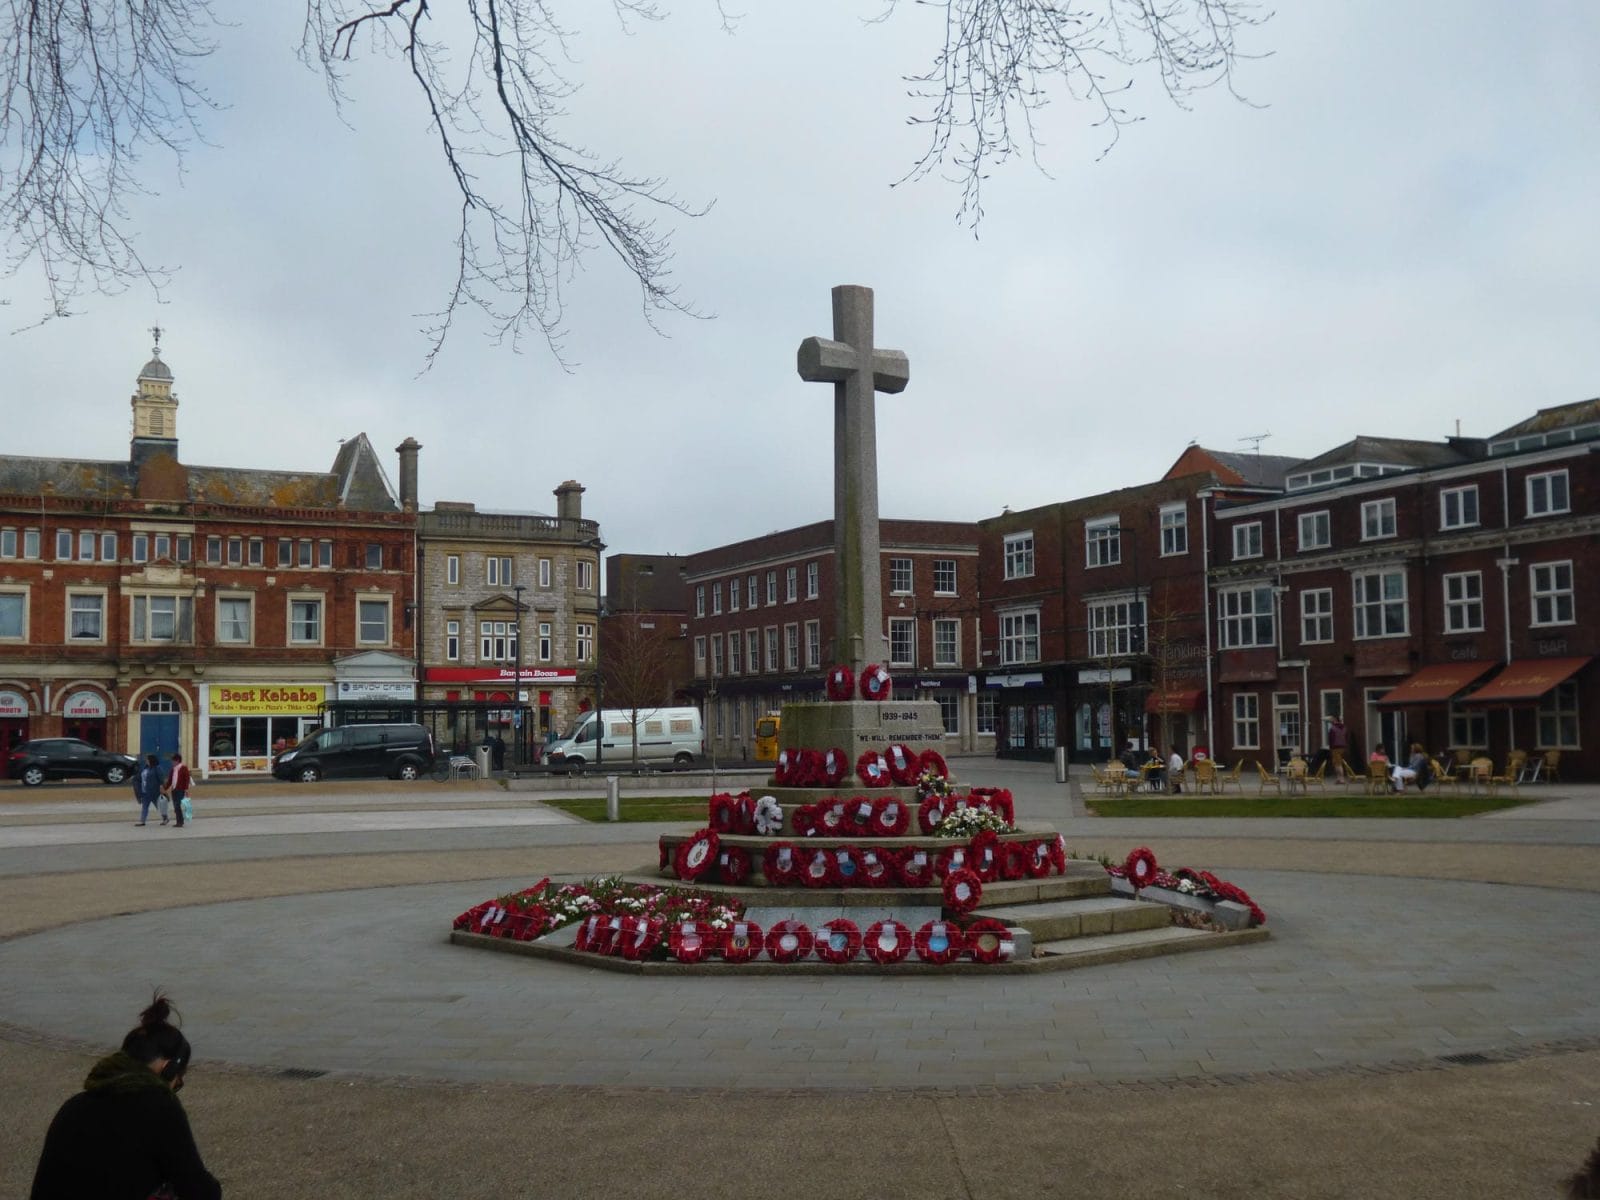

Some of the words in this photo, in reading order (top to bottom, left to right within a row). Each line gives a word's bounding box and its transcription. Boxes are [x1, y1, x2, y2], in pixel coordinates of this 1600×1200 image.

[1538, 639, 1568, 655] BAR
[534, 669, 558, 677] Booze
[220, 688, 255, 702] Best
[259, 688, 317, 702] Kebabs
[882, 712, 918, 720] 1939-1945
[888, 733, 922, 741] REMEMBER
